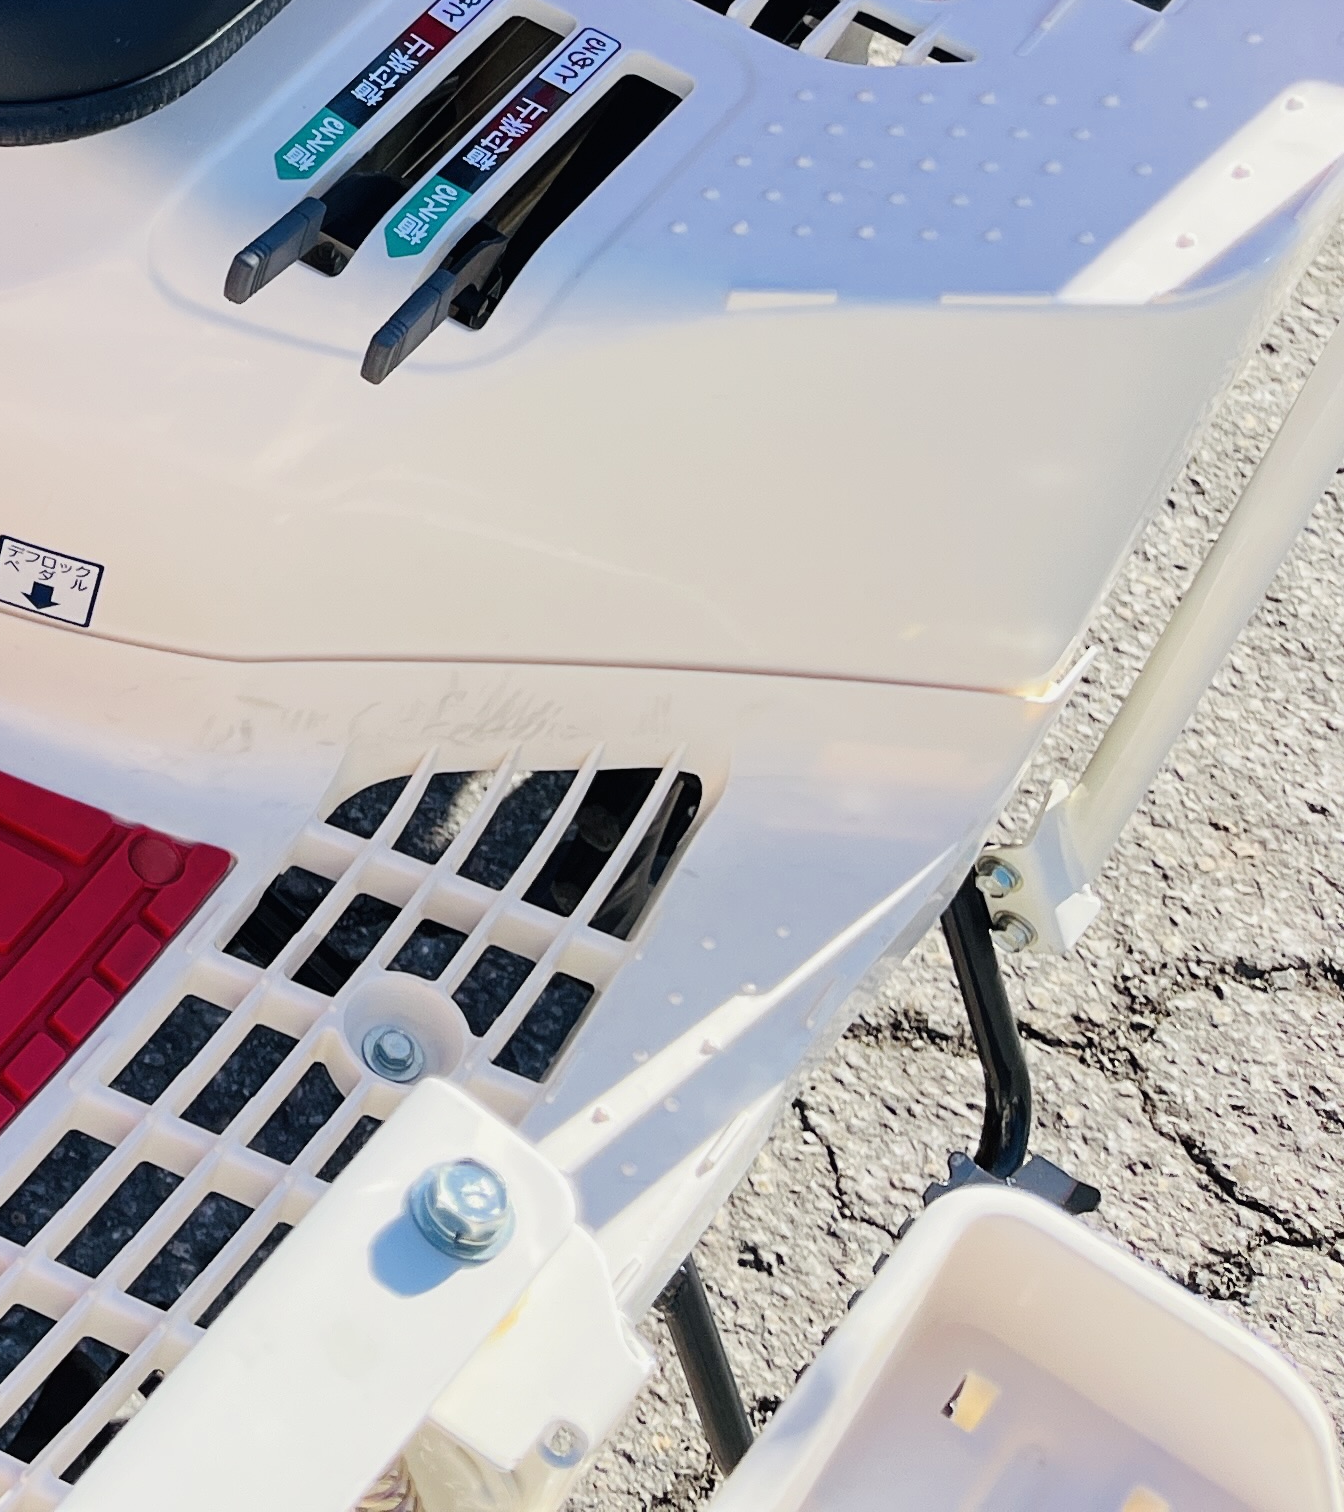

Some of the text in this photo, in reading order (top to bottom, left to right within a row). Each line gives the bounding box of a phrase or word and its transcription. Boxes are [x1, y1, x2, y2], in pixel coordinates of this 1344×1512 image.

[351, 34, 435, 108] 植付条止
[555, 34, 607, 84] とめる
[283, 117, 345, 173] 植える
[463, 97, 548, 172] 植付条止
[394, 183, 459, 245] 植える
[8, 544, 91, 578] デフロック
